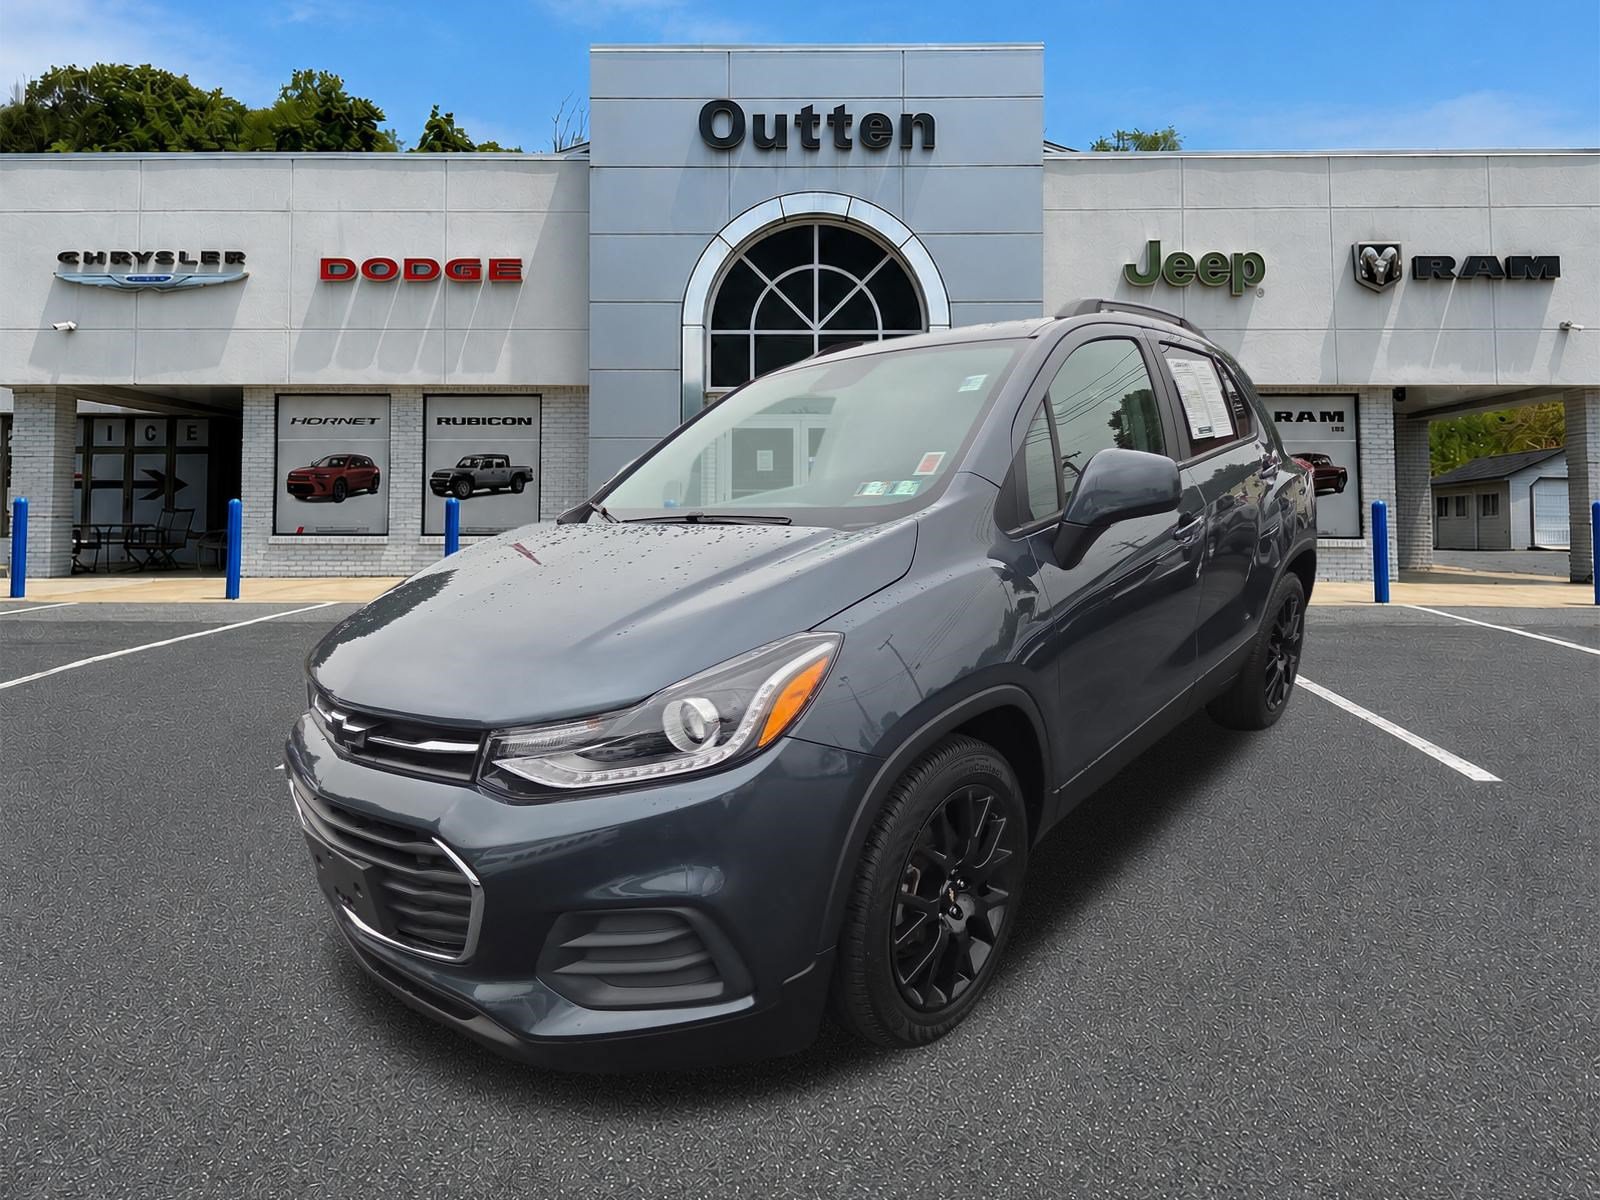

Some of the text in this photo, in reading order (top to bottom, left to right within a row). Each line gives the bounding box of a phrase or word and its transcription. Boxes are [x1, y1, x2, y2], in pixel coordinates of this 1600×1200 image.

[699, 99, 936, 150] Outten
[57, 251, 247, 266] CHRYSLER
[1123, 240, 1266, 296] Jeep
[1411, 255, 1561, 280] RAM
[320, 257, 523, 283] DODGE
[290, 416, 381, 426] HORNET
[436, 416, 533, 427] RUBICON
[1274, 410, 1345, 423] RAM
